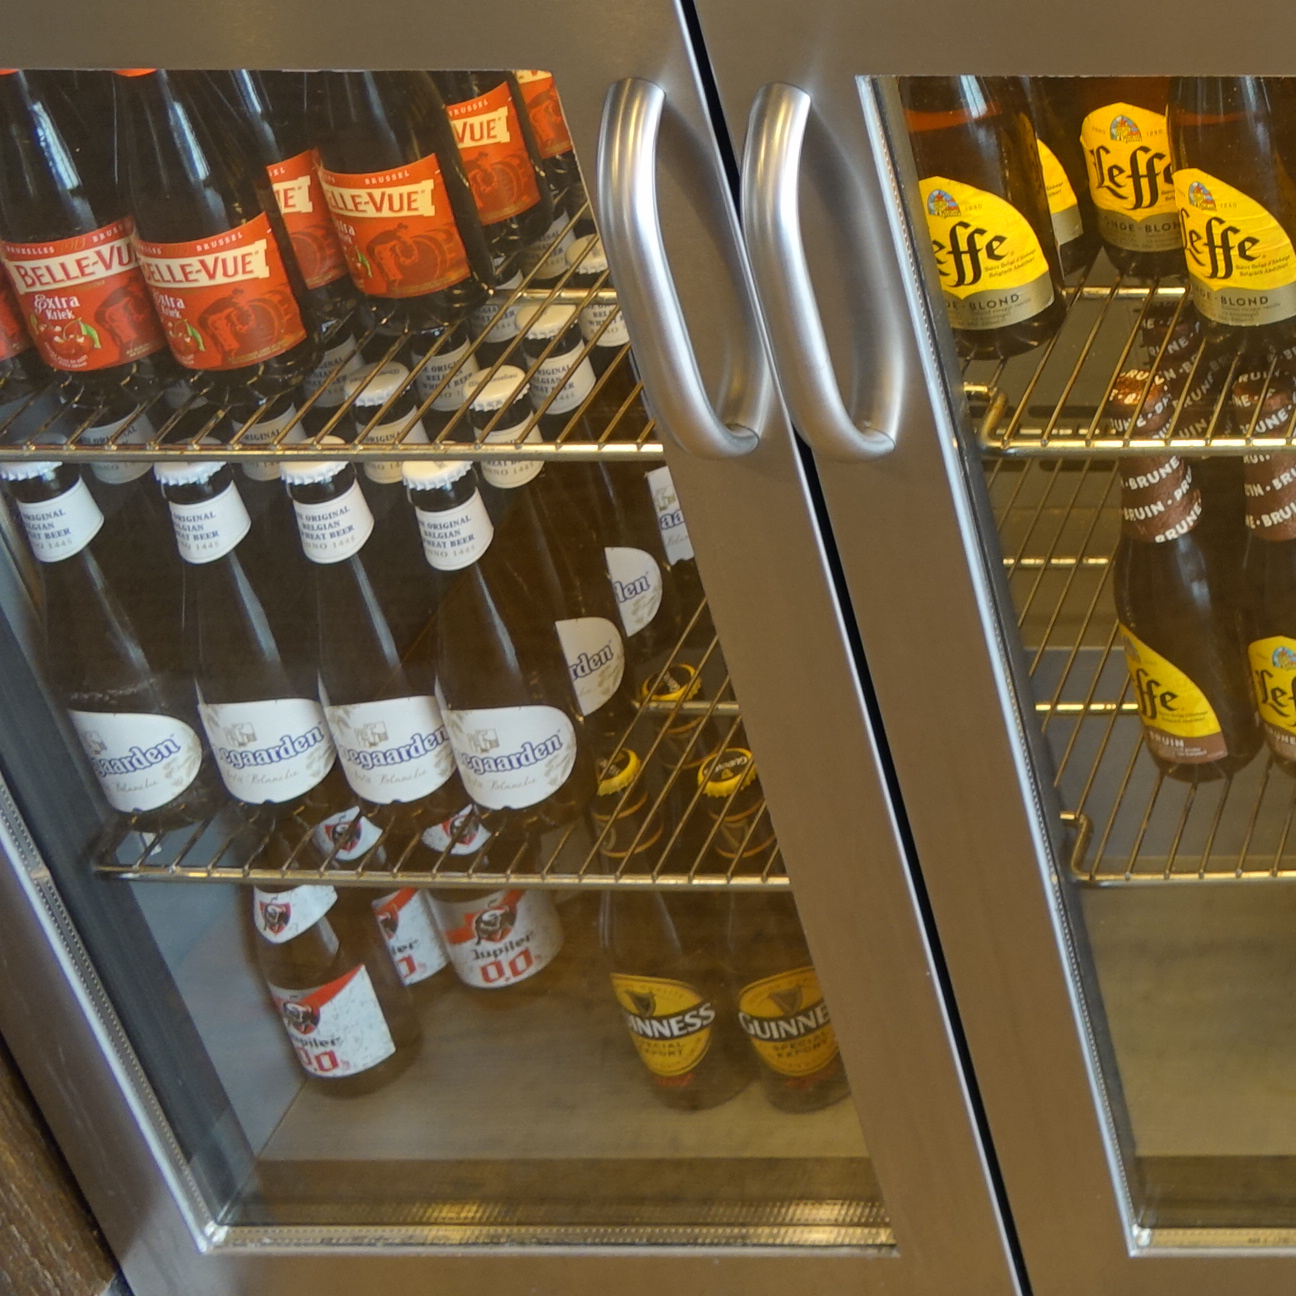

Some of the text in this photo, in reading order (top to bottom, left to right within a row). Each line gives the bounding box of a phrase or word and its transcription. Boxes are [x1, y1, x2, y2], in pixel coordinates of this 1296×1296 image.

[364, 170, 410, 185] BRUSSEL
[196, 232, 243, 252] BRUSSEL
[932, 220, 1009, 287] effe
[964, 293, 1020, 310] BLOND
[1220, 296, 1269, 305] BLOND
[1128, 456, 1180, 491] BRUNE
[305, 506, 351, 522] ORIGINAL
[425, 515, 472, 531] ORIGINAL
[45, 527, 72, 540] BEER
[196, 530, 220, 541] BEER
[329, 525, 355, 538] BEER
[452, 533, 476, 547] BEER
[219, 723, 324, 769] egaarden
[464, 731, 563, 776] egaarden
[739, 1005, 830, 1039] GUINNE
